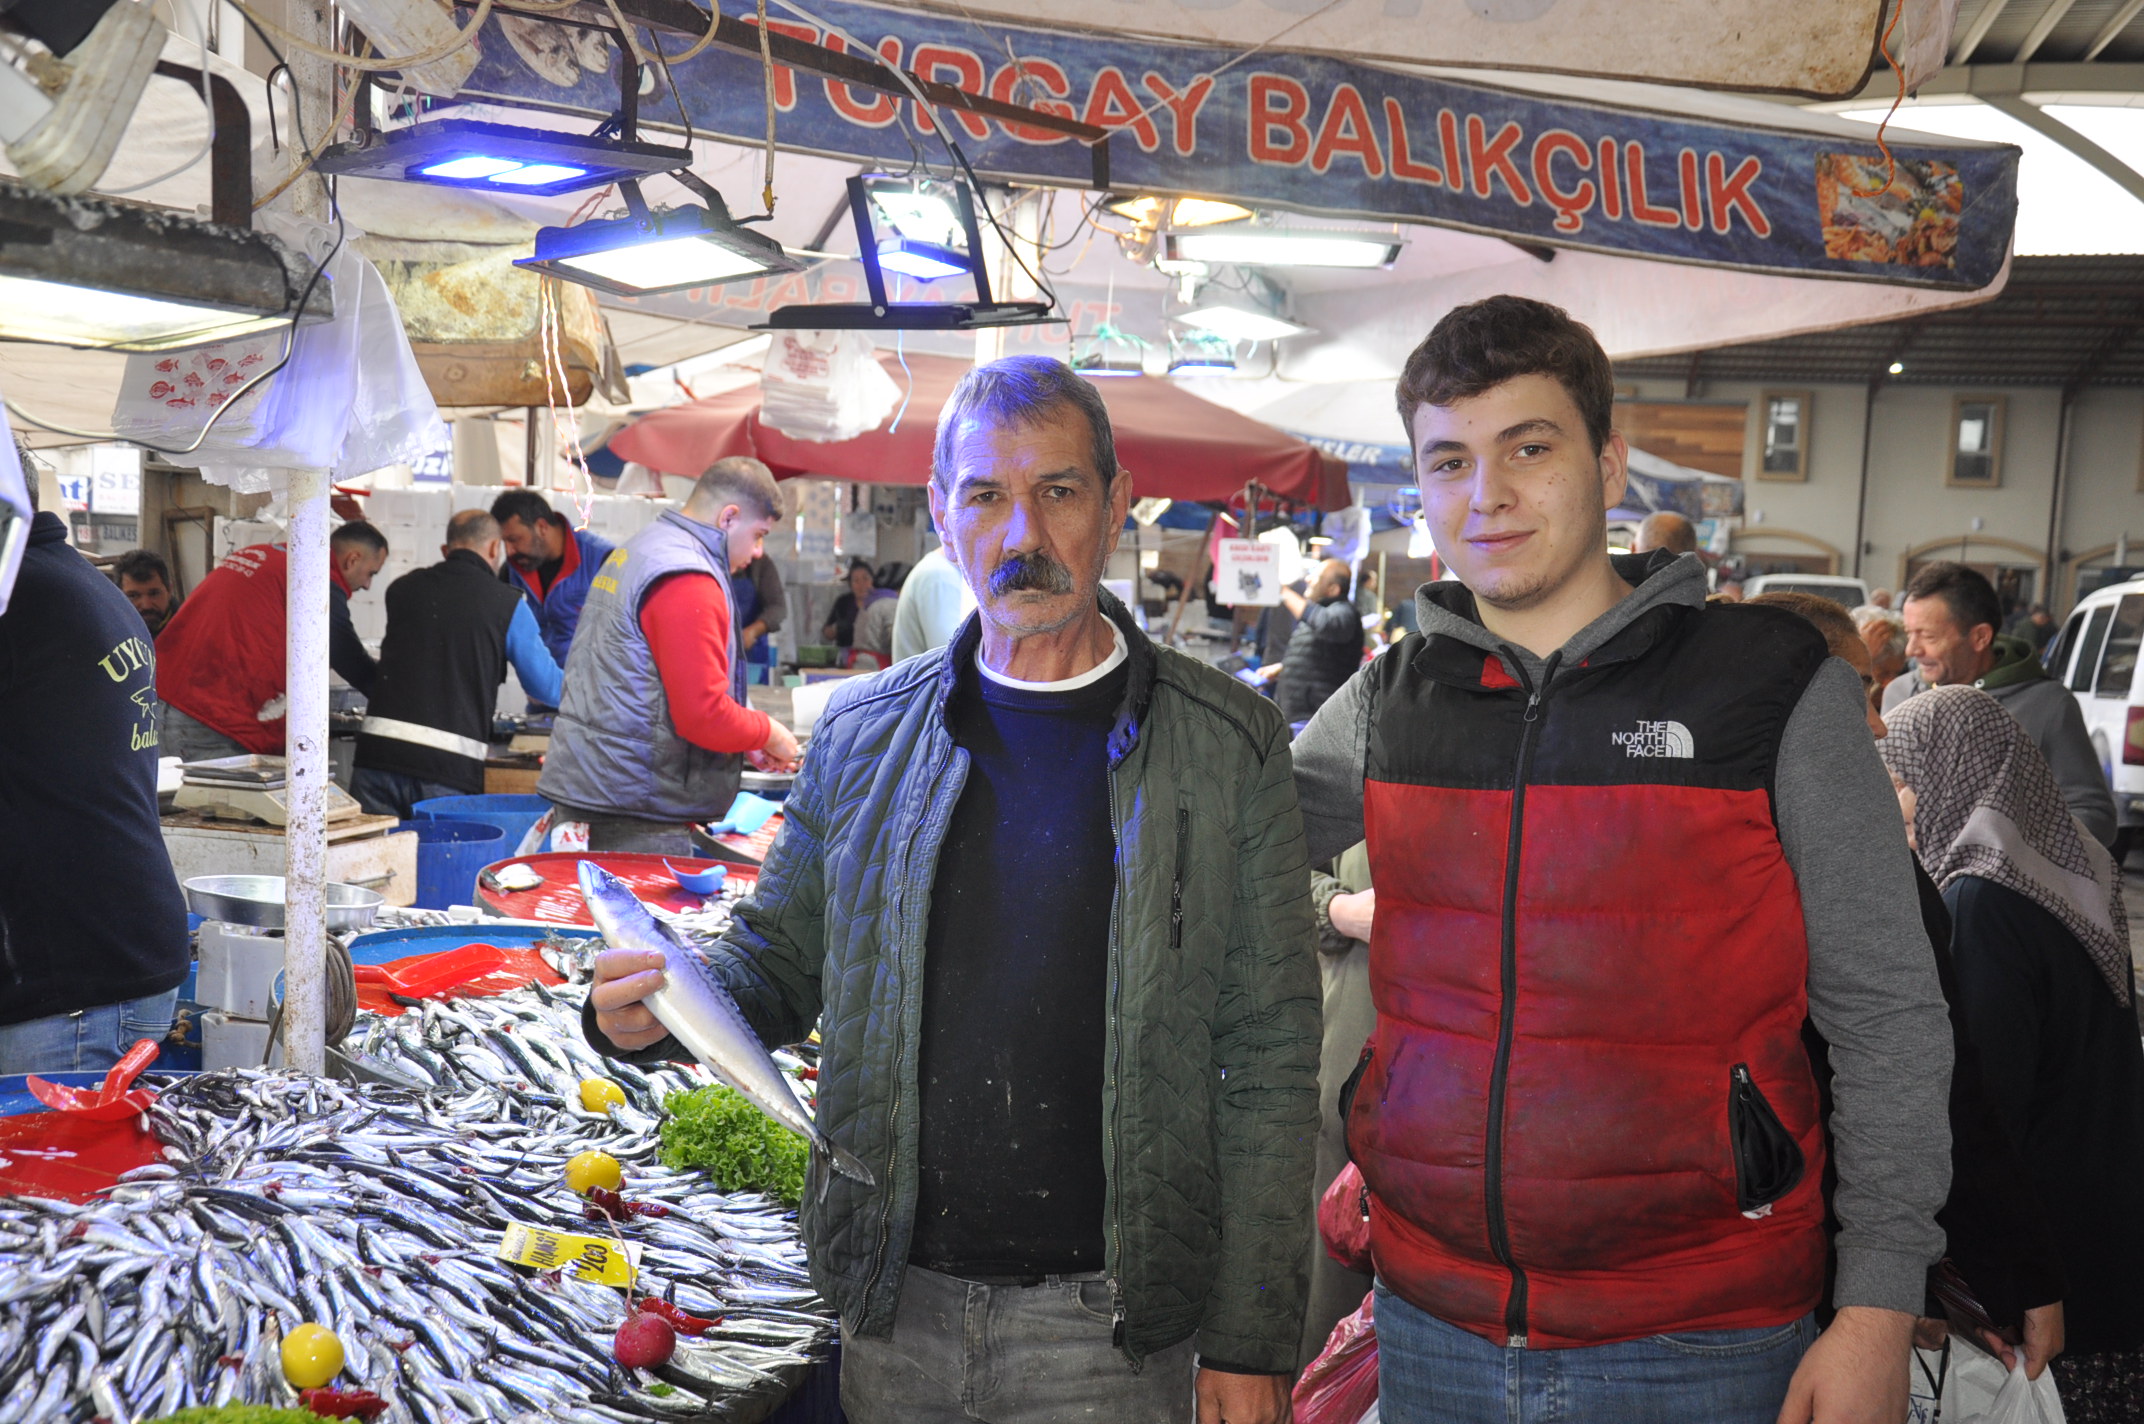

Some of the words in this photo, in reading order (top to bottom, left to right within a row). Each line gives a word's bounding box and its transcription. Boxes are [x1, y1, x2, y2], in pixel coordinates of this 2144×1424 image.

[737, 11, 1216, 157] TURGAY
[1246, 71, 1773, 240] BALIKÇILIK
[1635, 719, 1667, 733] THE
[1611, 731, 1666, 746] NORTH
[1626, 743, 1666, 758] FACE
